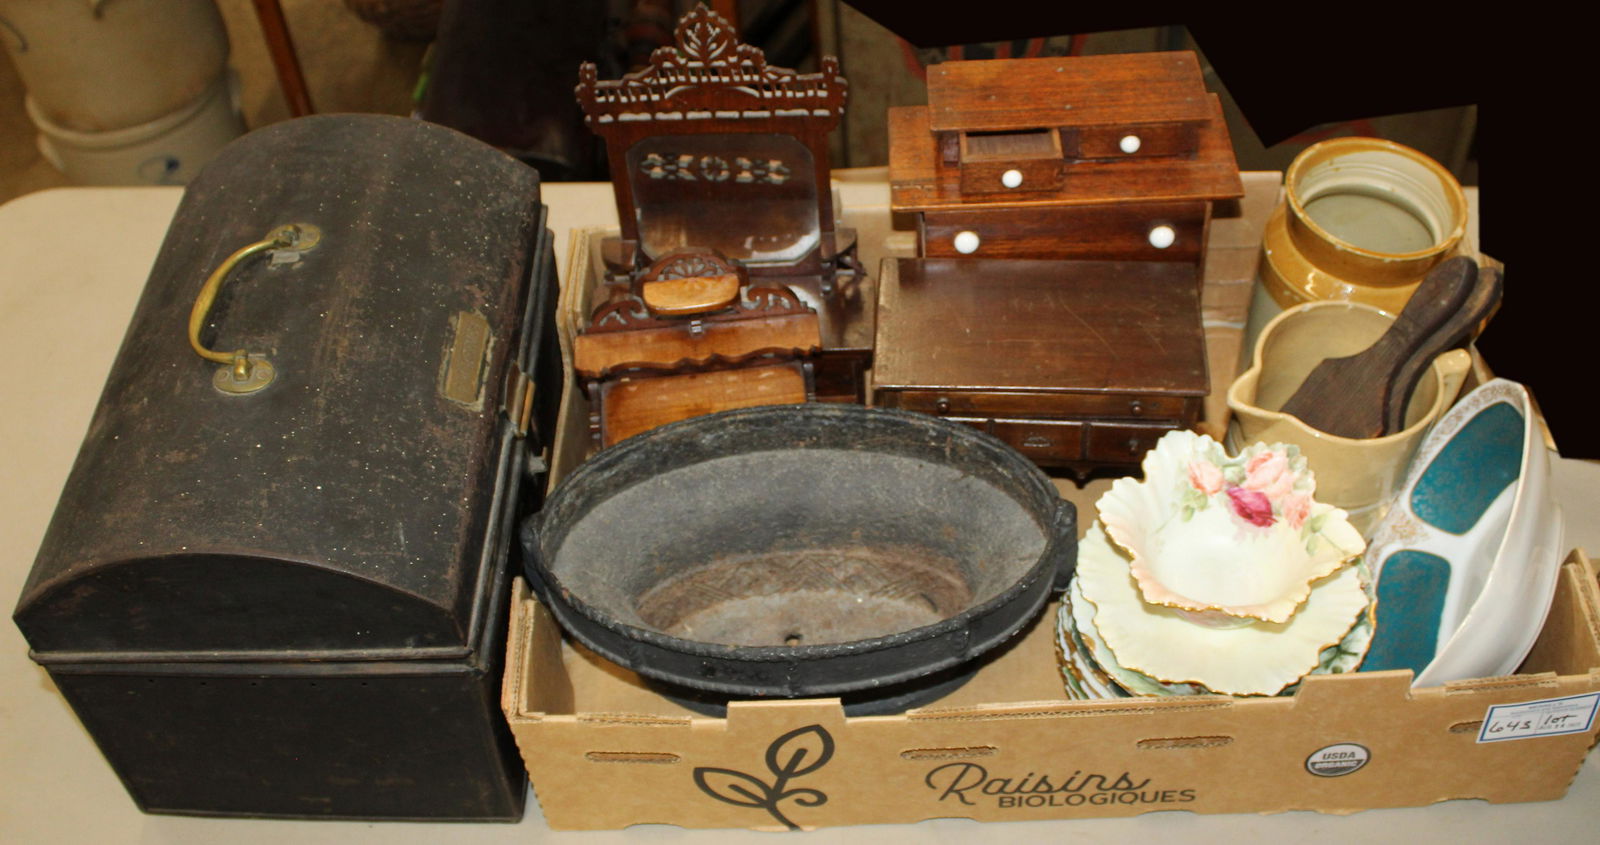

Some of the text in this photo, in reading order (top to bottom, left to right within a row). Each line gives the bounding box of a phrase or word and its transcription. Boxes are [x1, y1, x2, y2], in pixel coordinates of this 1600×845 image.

[1322, 751, 1356, 760] USDA
[1314, 760, 1358, 769] ORGANIC
[925, 762, 1151, 806] Raisins
[998, 789, 1196, 807] BIOLOGIQUES
